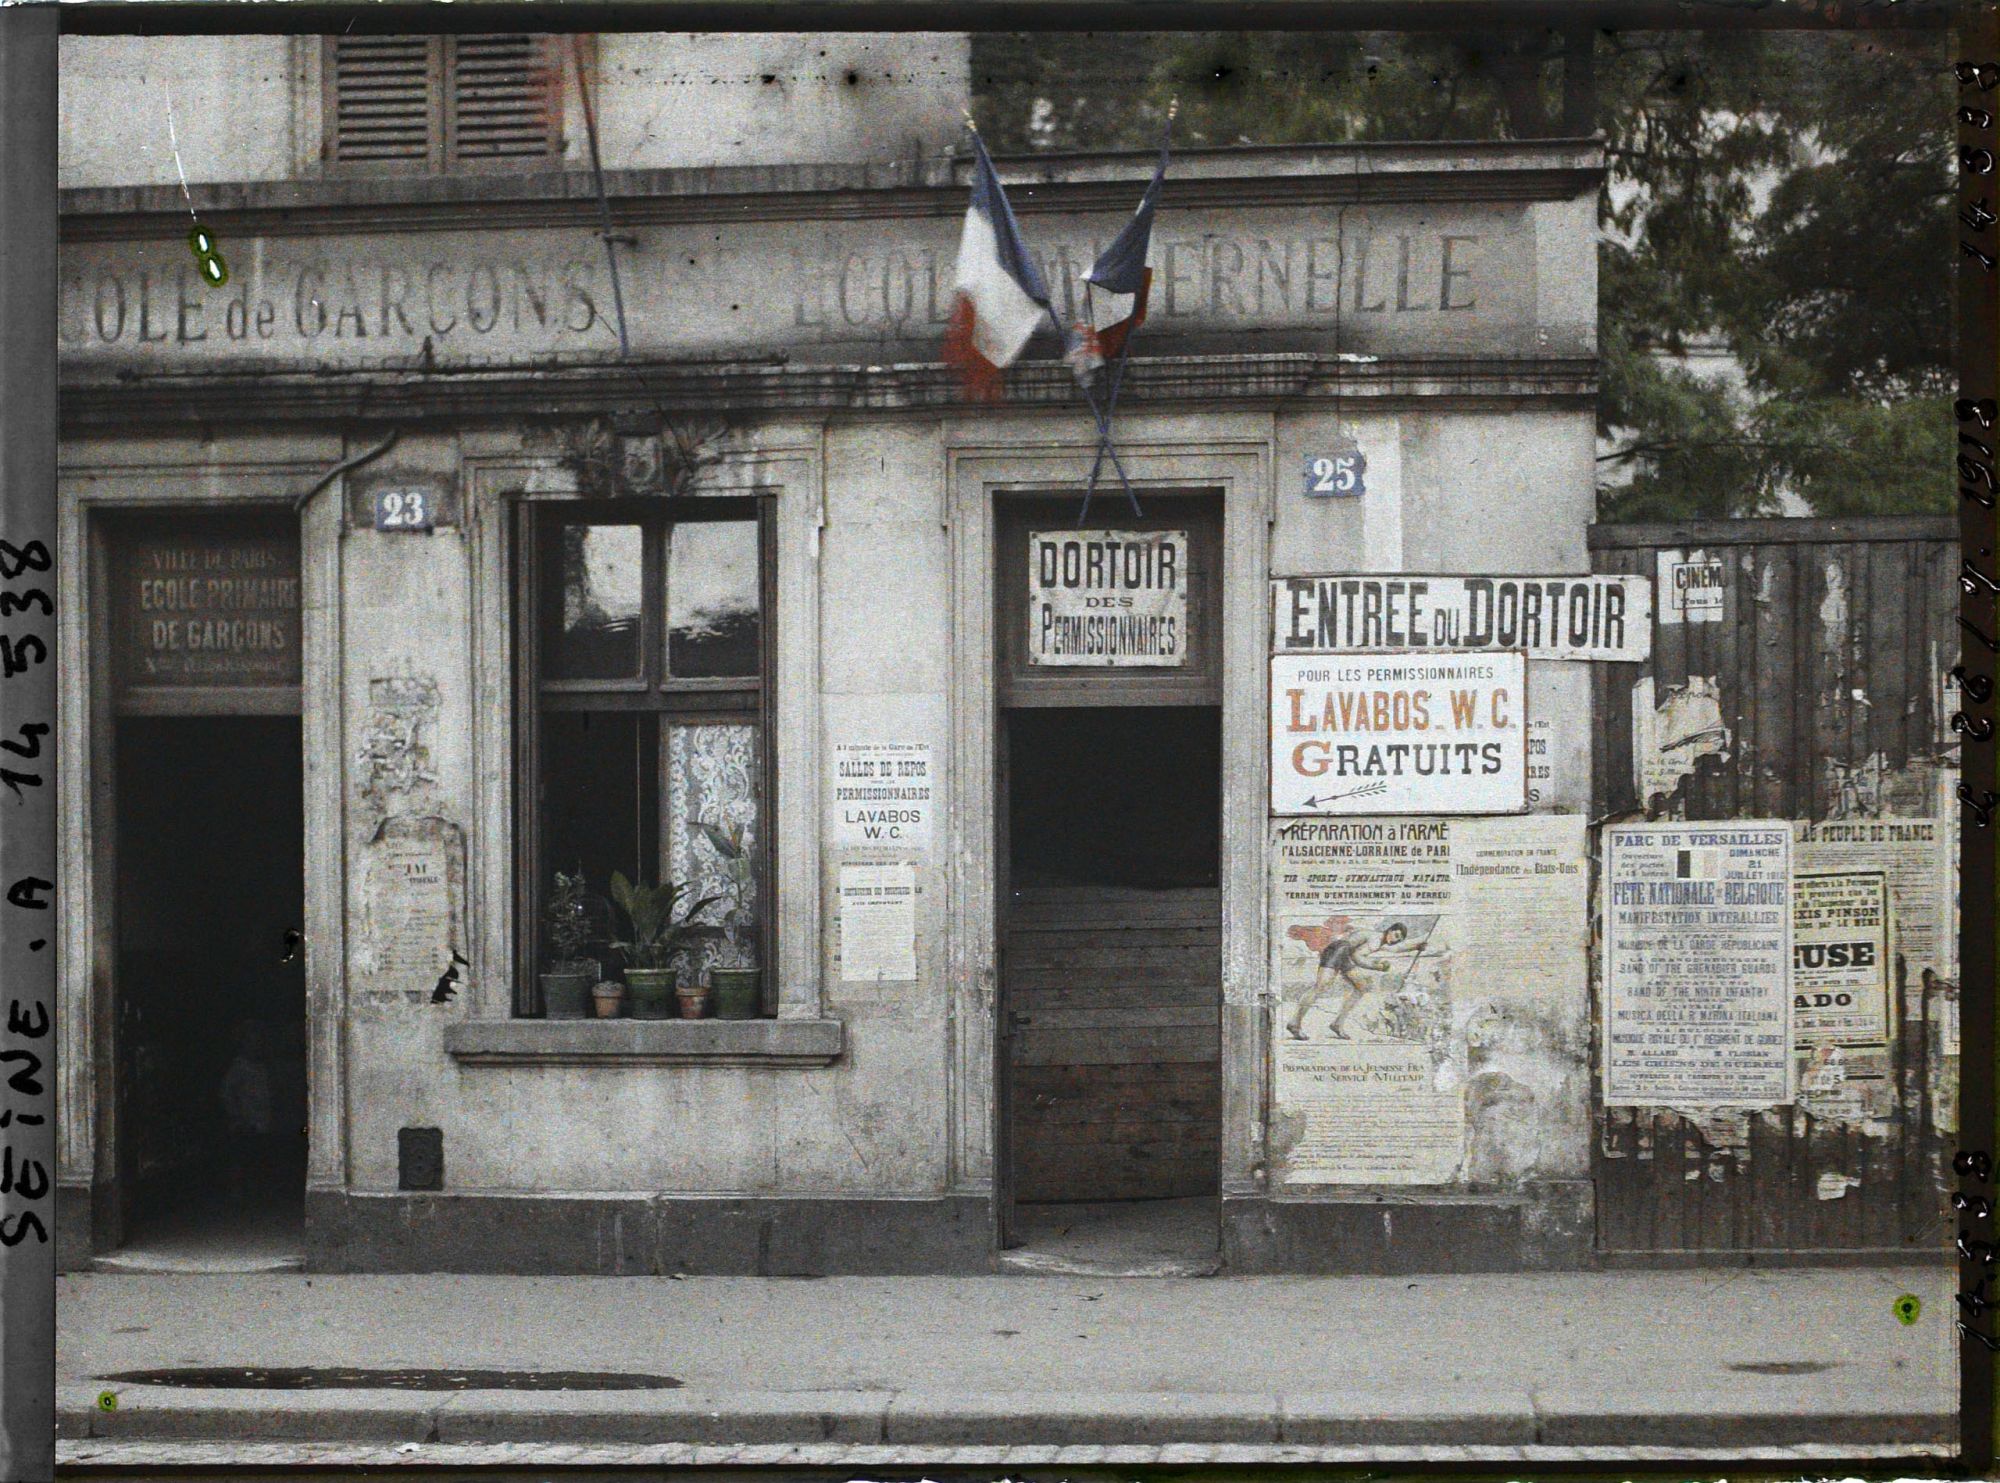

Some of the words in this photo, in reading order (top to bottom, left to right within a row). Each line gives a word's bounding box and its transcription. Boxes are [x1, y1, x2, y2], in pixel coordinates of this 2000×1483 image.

[226, 284, 274, 341] de
[1312, 456, 1356, 491] 25
[383, 492, 424, 526] 23
[1039, 541, 1176, 589] DORTOIR
[1085, 597, 1134, 608] DES
[1433, 608, 1460, 646] DU
[1463, 578, 1626, 649] DORTOIR
[152, 619, 180, 650] DE
[1041, 603, 1176, 655] PERMISSIONNAIRES
[1297, 670, 1331, 681] POUR
[1337, 669, 1362, 681] LES
[1367, 667, 1494, 681] PERMISSIONNAIRES
[1286, 688, 1430, 733] LAVABOS
[1291, 740, 1502, 777] GRATUITS
[839, 761, 875, 778] SALLES
[880, 761, 893, 777] DE
[897, 761, 927, 777] REPOS
[836, 787, 930, 801] PERMISSIONNAIRES
[845, 810, 921, 824] LAVABOS
[1387, 825, 1396, 840] à
[1822, 825, 1866, 842] PEUPLE
[1870, 825, 1884, 841] DE
[1889, 824, 1934, 841] FRANCE
[1615, 835, 1654, 847] PARC
[1662, 835, 1681, 846] DE
[1688, 834, 1783, 846] VERSAILLES
[1411, 846, 1422, 856] de
[1729, 848, 1780, 857] DIMANCHE
[1747, 860, 1762, 868] 21
[1306, 874, 1338, 883] SPORTS
[1345, 874, 1405, 883] GYMNASTIQUE
[1725, 870, 1763, 880] JUILLET
[1285, 891, 1320, 900] TERRAIN
[1401, 891, 1412, 900] AU
[1415, 891, 1451, 900] PERREU
[1649, 881, 1715, 905] NATIONALE
[1724, 881, 1785, 905] BELGIQUE
[1619, 911, 1700, 925] MANIFESTATION
[1827, 907, 1880, 918] PINSON
[1673, 940, 1684, 950] LA
[1723, 1060, 1785, 1068] GUERRE
[1312, 1074, 1324, 1082] AU
[1330, 1073, 1368, 1082] SERVICE
